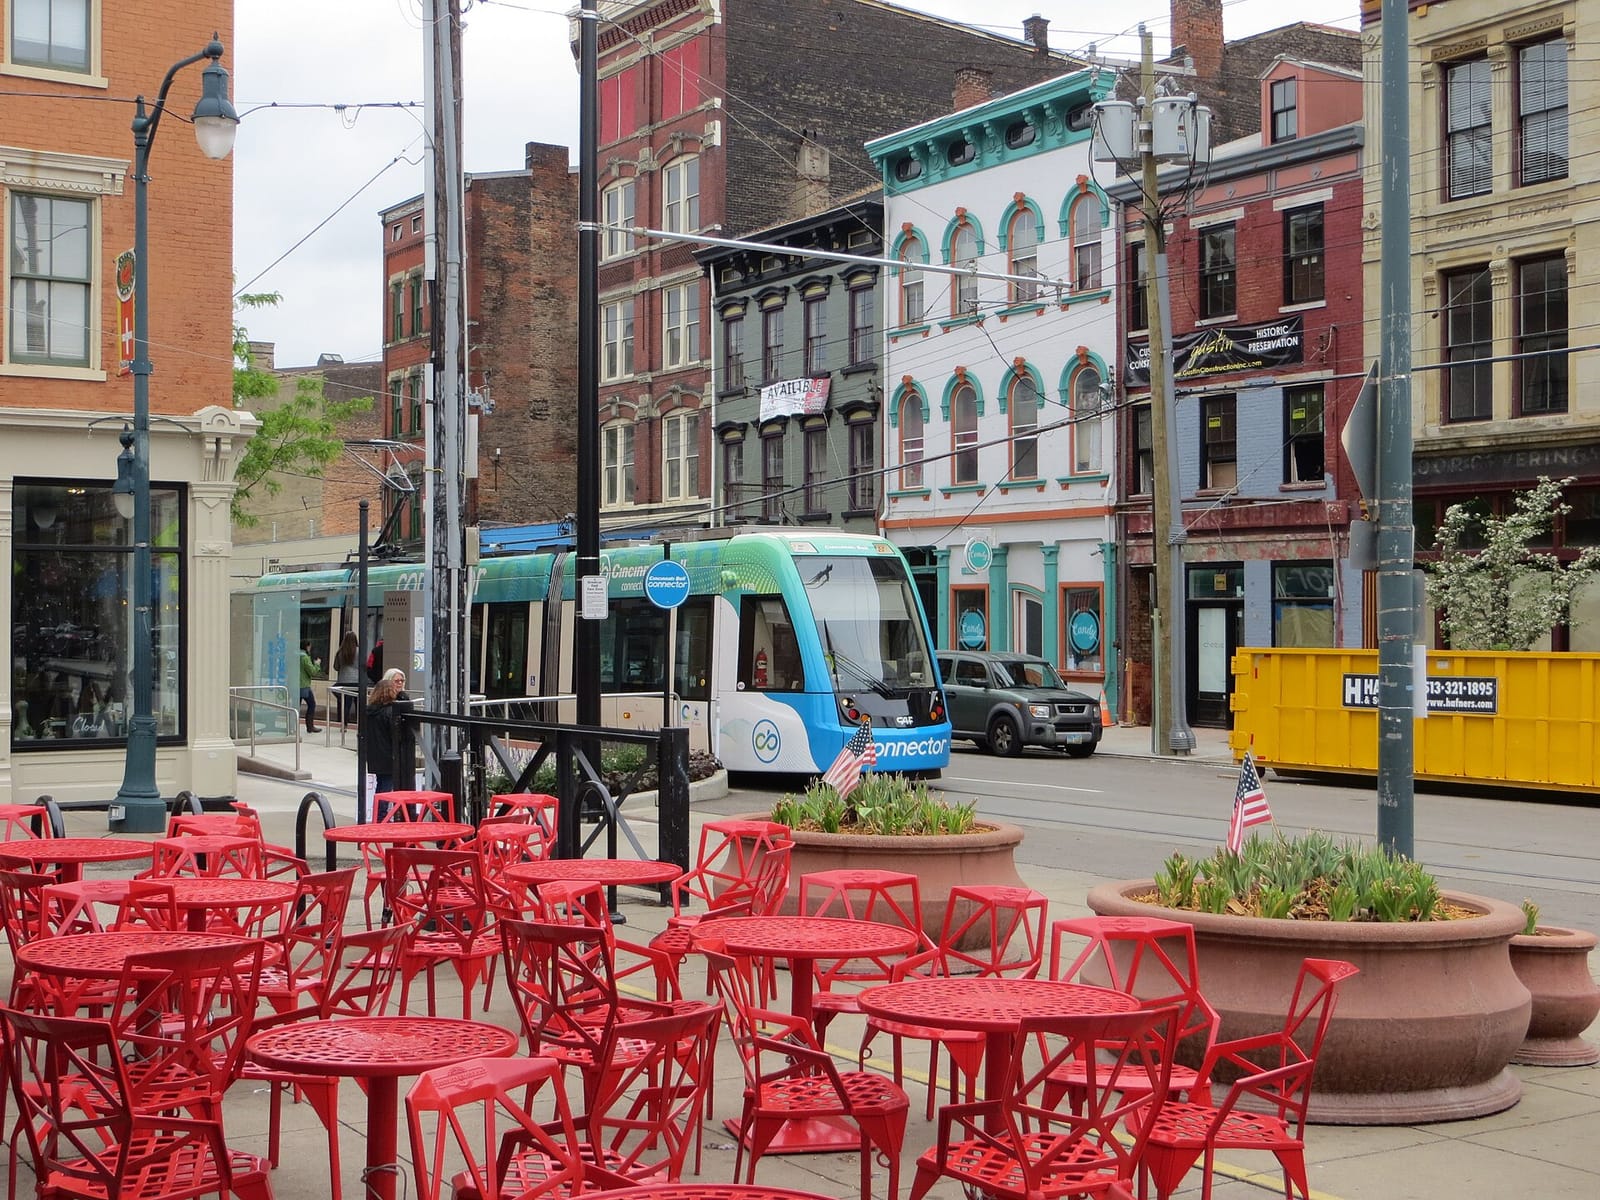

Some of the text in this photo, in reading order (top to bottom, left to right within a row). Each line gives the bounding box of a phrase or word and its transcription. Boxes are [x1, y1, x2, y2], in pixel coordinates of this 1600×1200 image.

[1256, 325, 1289, 339] HISTORIC
[1139, 348, 1151, 358] CUS
[1248, 337, 1299, 353] PRESERVATION
[1129, 360, 1151, 370] CONST
[1072, 624, 1097, 640] Candy
[1364, 678, 1380, 695] HA
[875, 737, 948, 758] onnector
